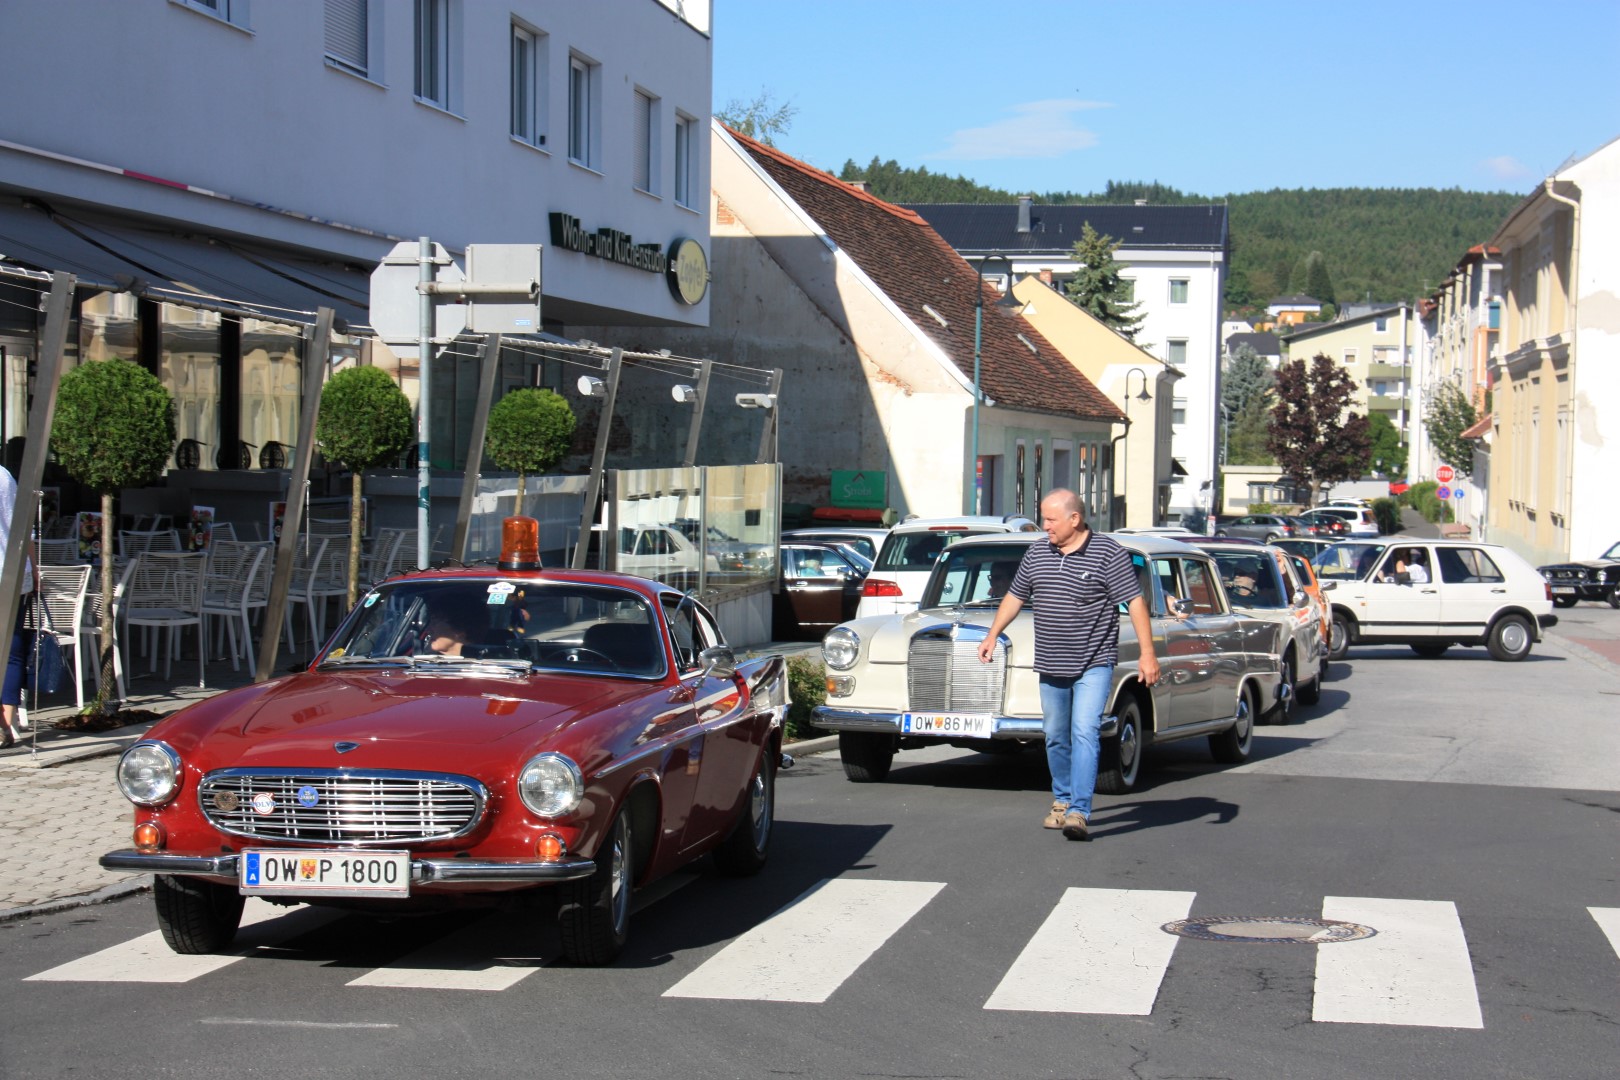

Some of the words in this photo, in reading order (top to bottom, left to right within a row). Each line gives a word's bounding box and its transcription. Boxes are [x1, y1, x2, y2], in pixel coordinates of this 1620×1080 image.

[561, 214, 593, 253] Wohn-
[595, 228, 612, 258] und
[614, 230, 667, 274] Küchenstudio
[1437, 470, 1453, 478] STOP
[915, 716, 934, 730] OW
[943, 717, 961, 731] 86
[964, 718, 984, 731] MW
[249, 873, 257, 881] A
[265, 857, 298, 882] OW
[319, 859, 332, 883] P
[340, 859, 397, 884] 1800
